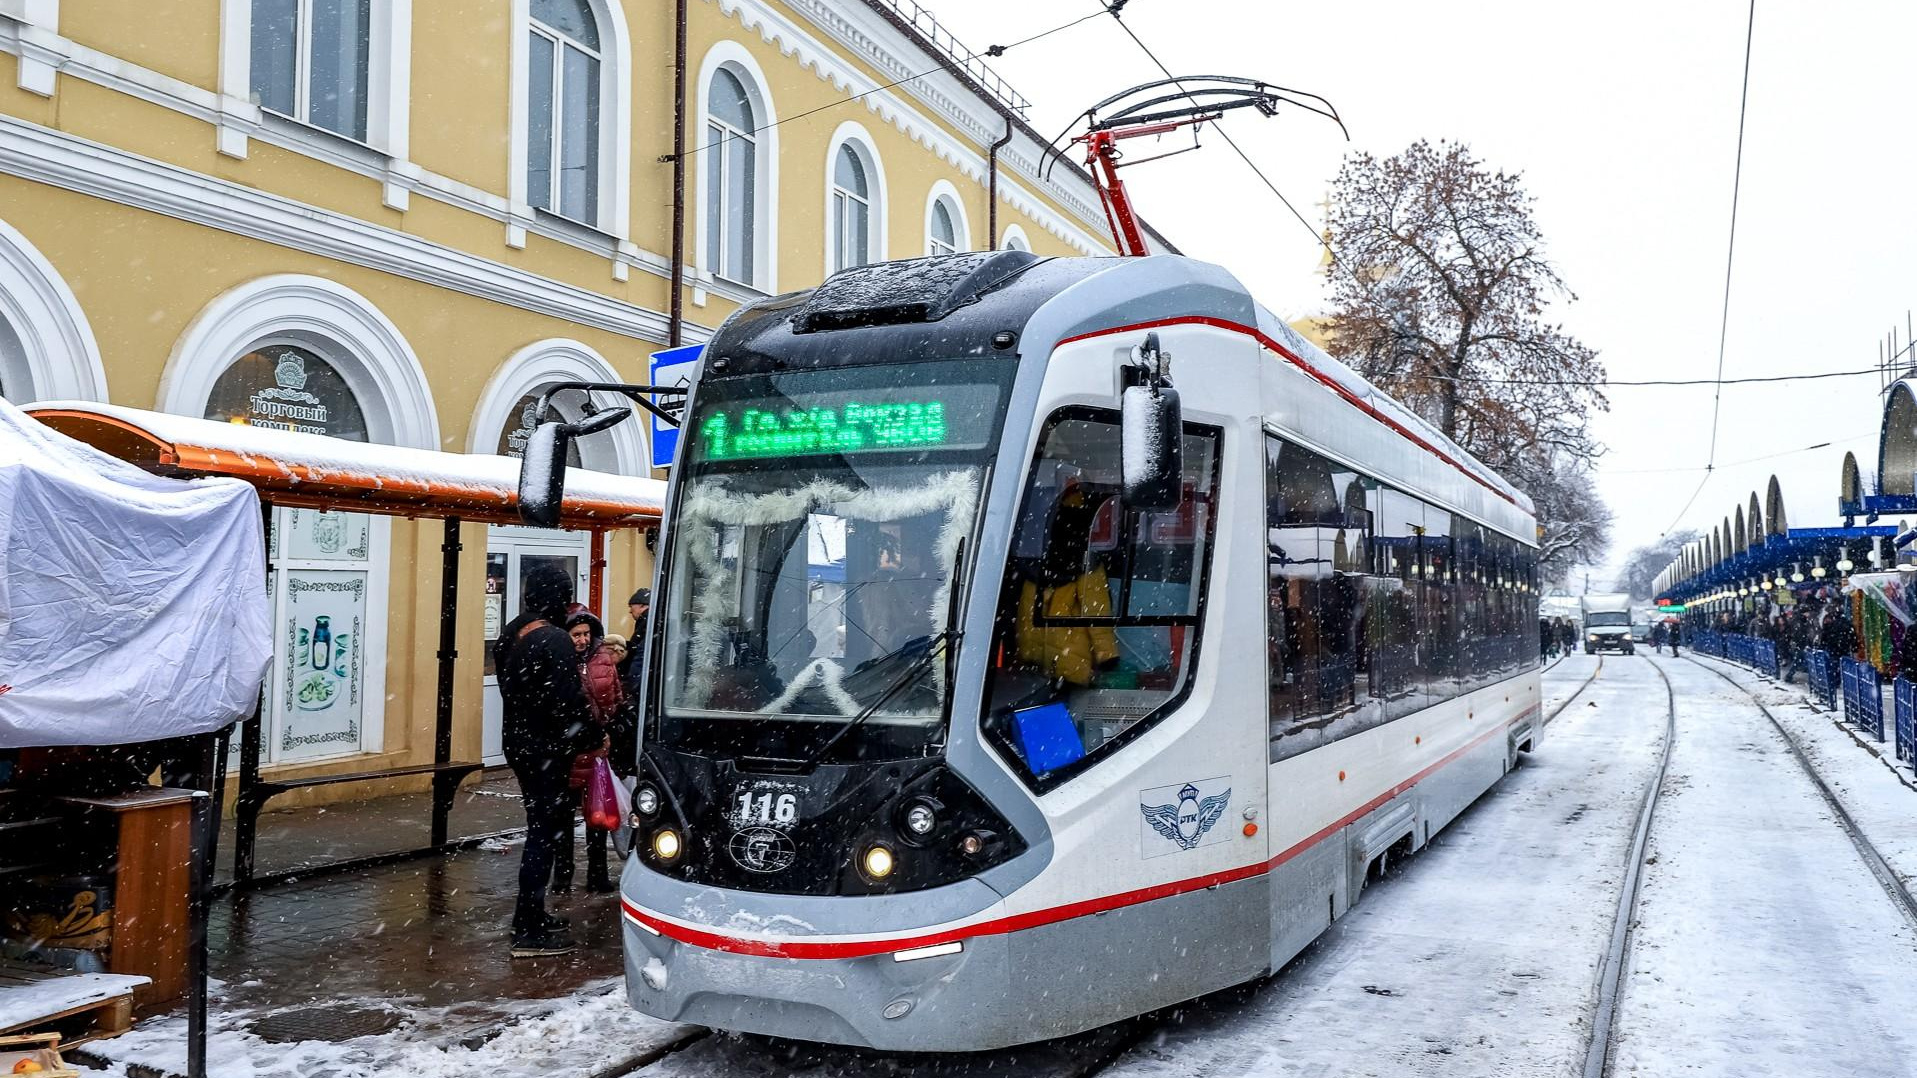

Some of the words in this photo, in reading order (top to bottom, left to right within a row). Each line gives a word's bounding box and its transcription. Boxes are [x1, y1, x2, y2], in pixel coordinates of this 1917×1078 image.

[250, 396, 327, 422] Торговый
[702, 411, 727, 456] 1
[738, 791, 797, 823] 116
